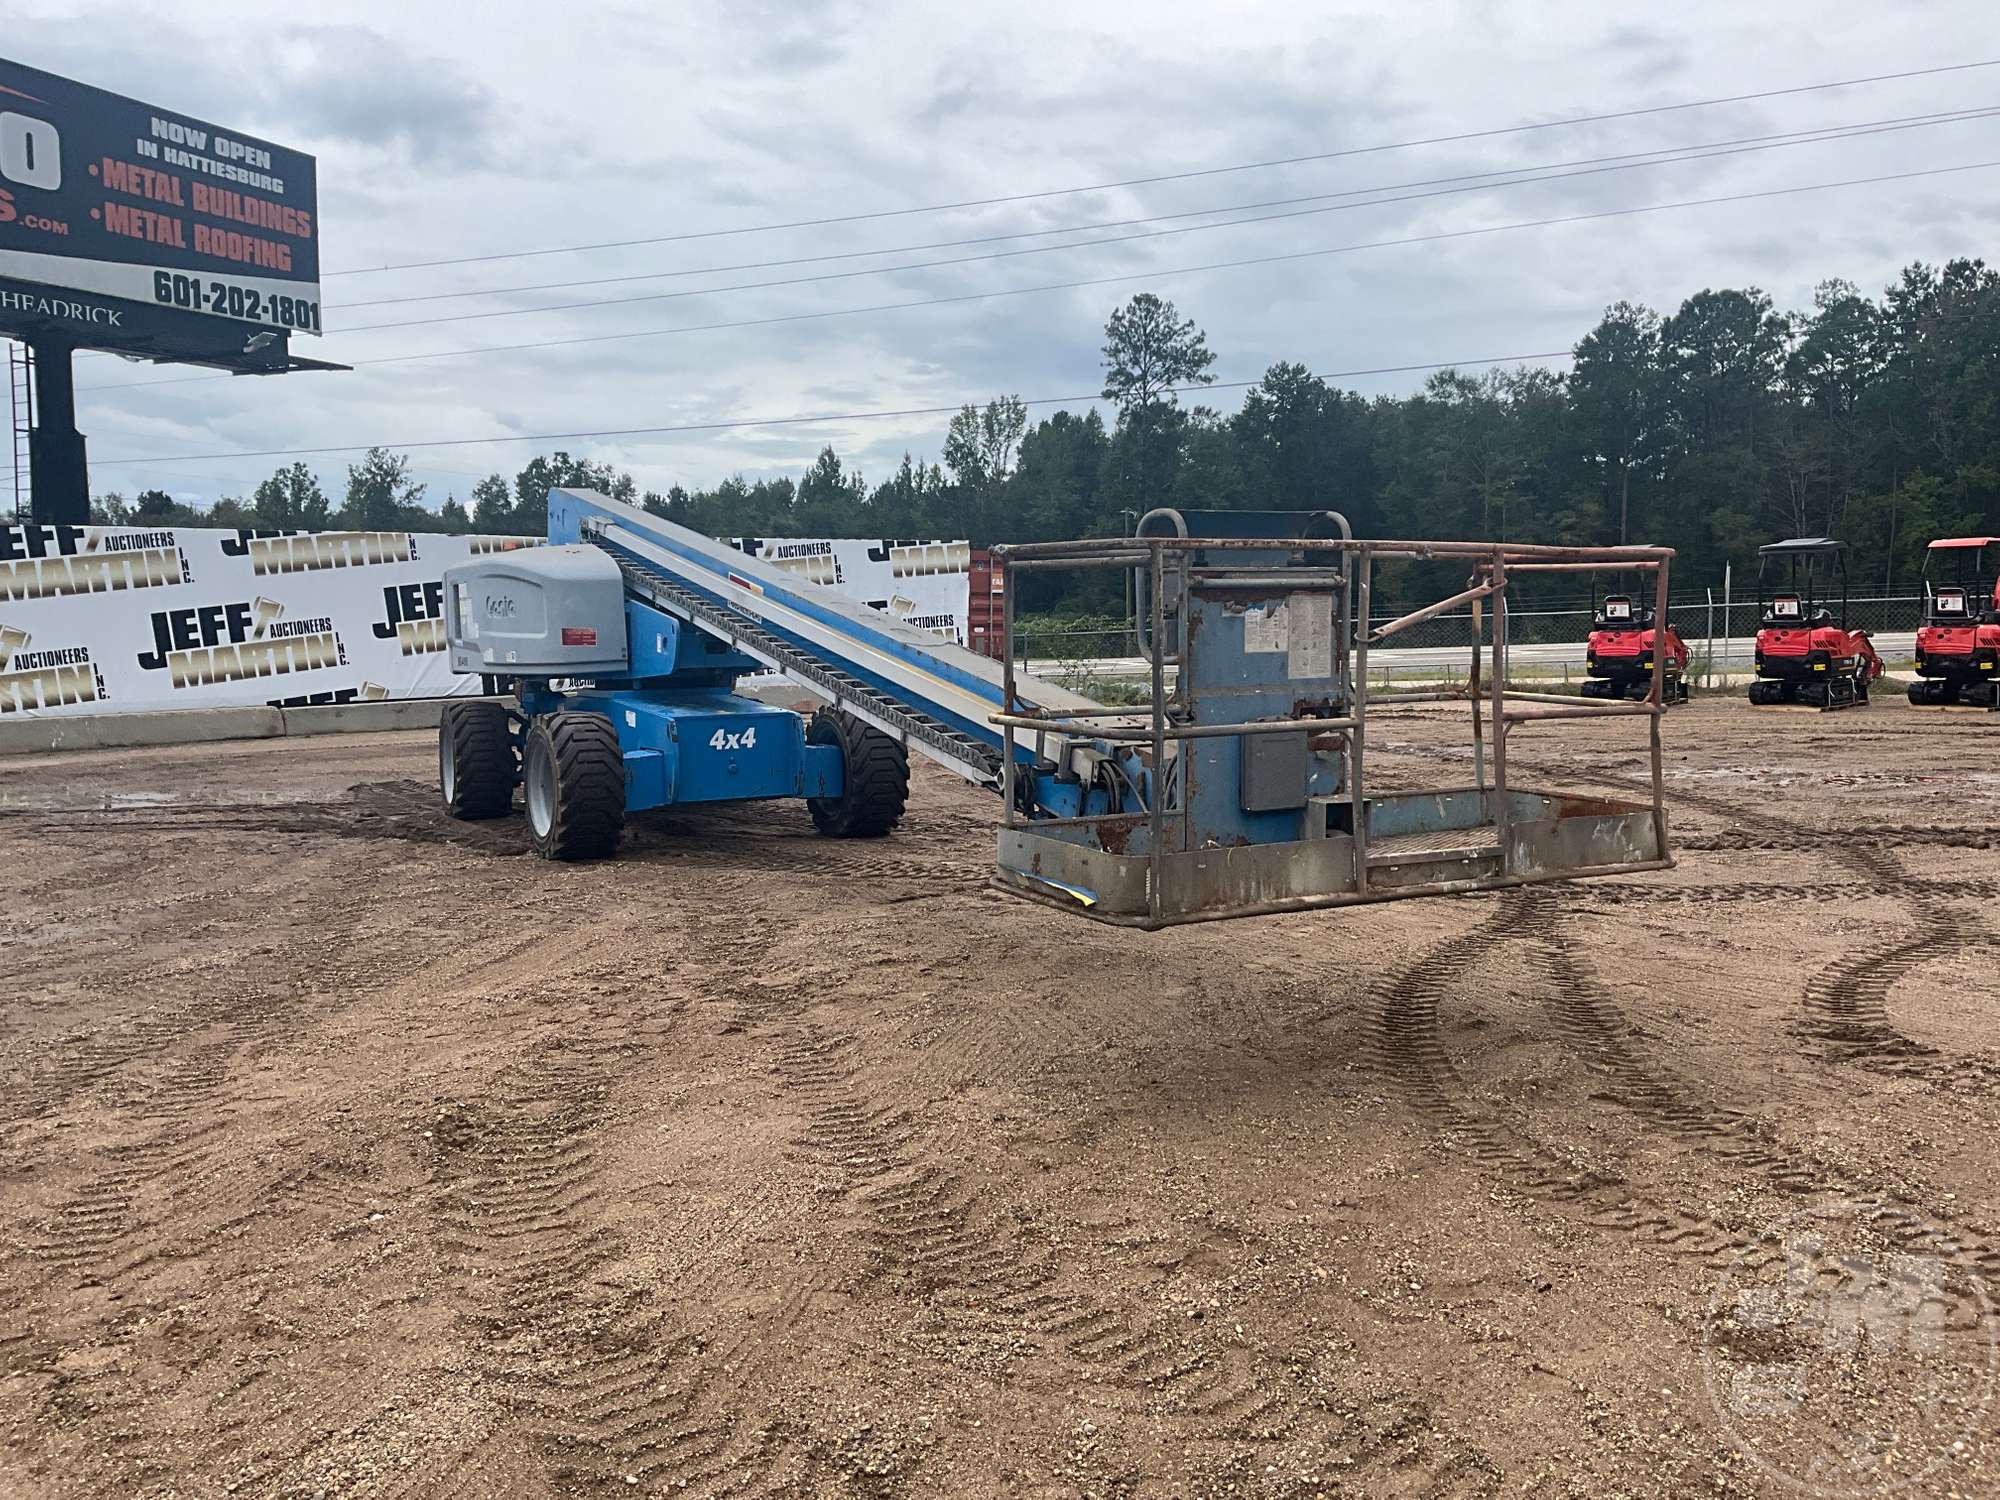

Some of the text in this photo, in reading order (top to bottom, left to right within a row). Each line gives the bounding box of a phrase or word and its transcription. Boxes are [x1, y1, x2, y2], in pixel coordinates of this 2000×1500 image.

[137, 138, 283, 194] IN HATTIESBURG
[151, 117, 271, 170] NOW OPEN
[102, 157, 311, 238] METAL BUILDINGS
[104, 202, 291, 272] METAL ROOFING
[0, 290, 123, 326] HEADRICK
[153, 270, 320, 331] 601-202-1801
[104, 531, 175, 552] AUCTIONEERS
[250, 533, 409, 576] MARTIN
[777, 542, 832, 559] AUCTIONEERS
[270, 617, 332, 638] AUCTIONEERS
[372, 581, 443, 638] JEF
[14, 647, 89, 671] AUCTIONEERS
[138, 603, 253, 670] JEFF
[167, 633, 337, 688] MARTIN
[709, 727, 756, 750] 4x4
